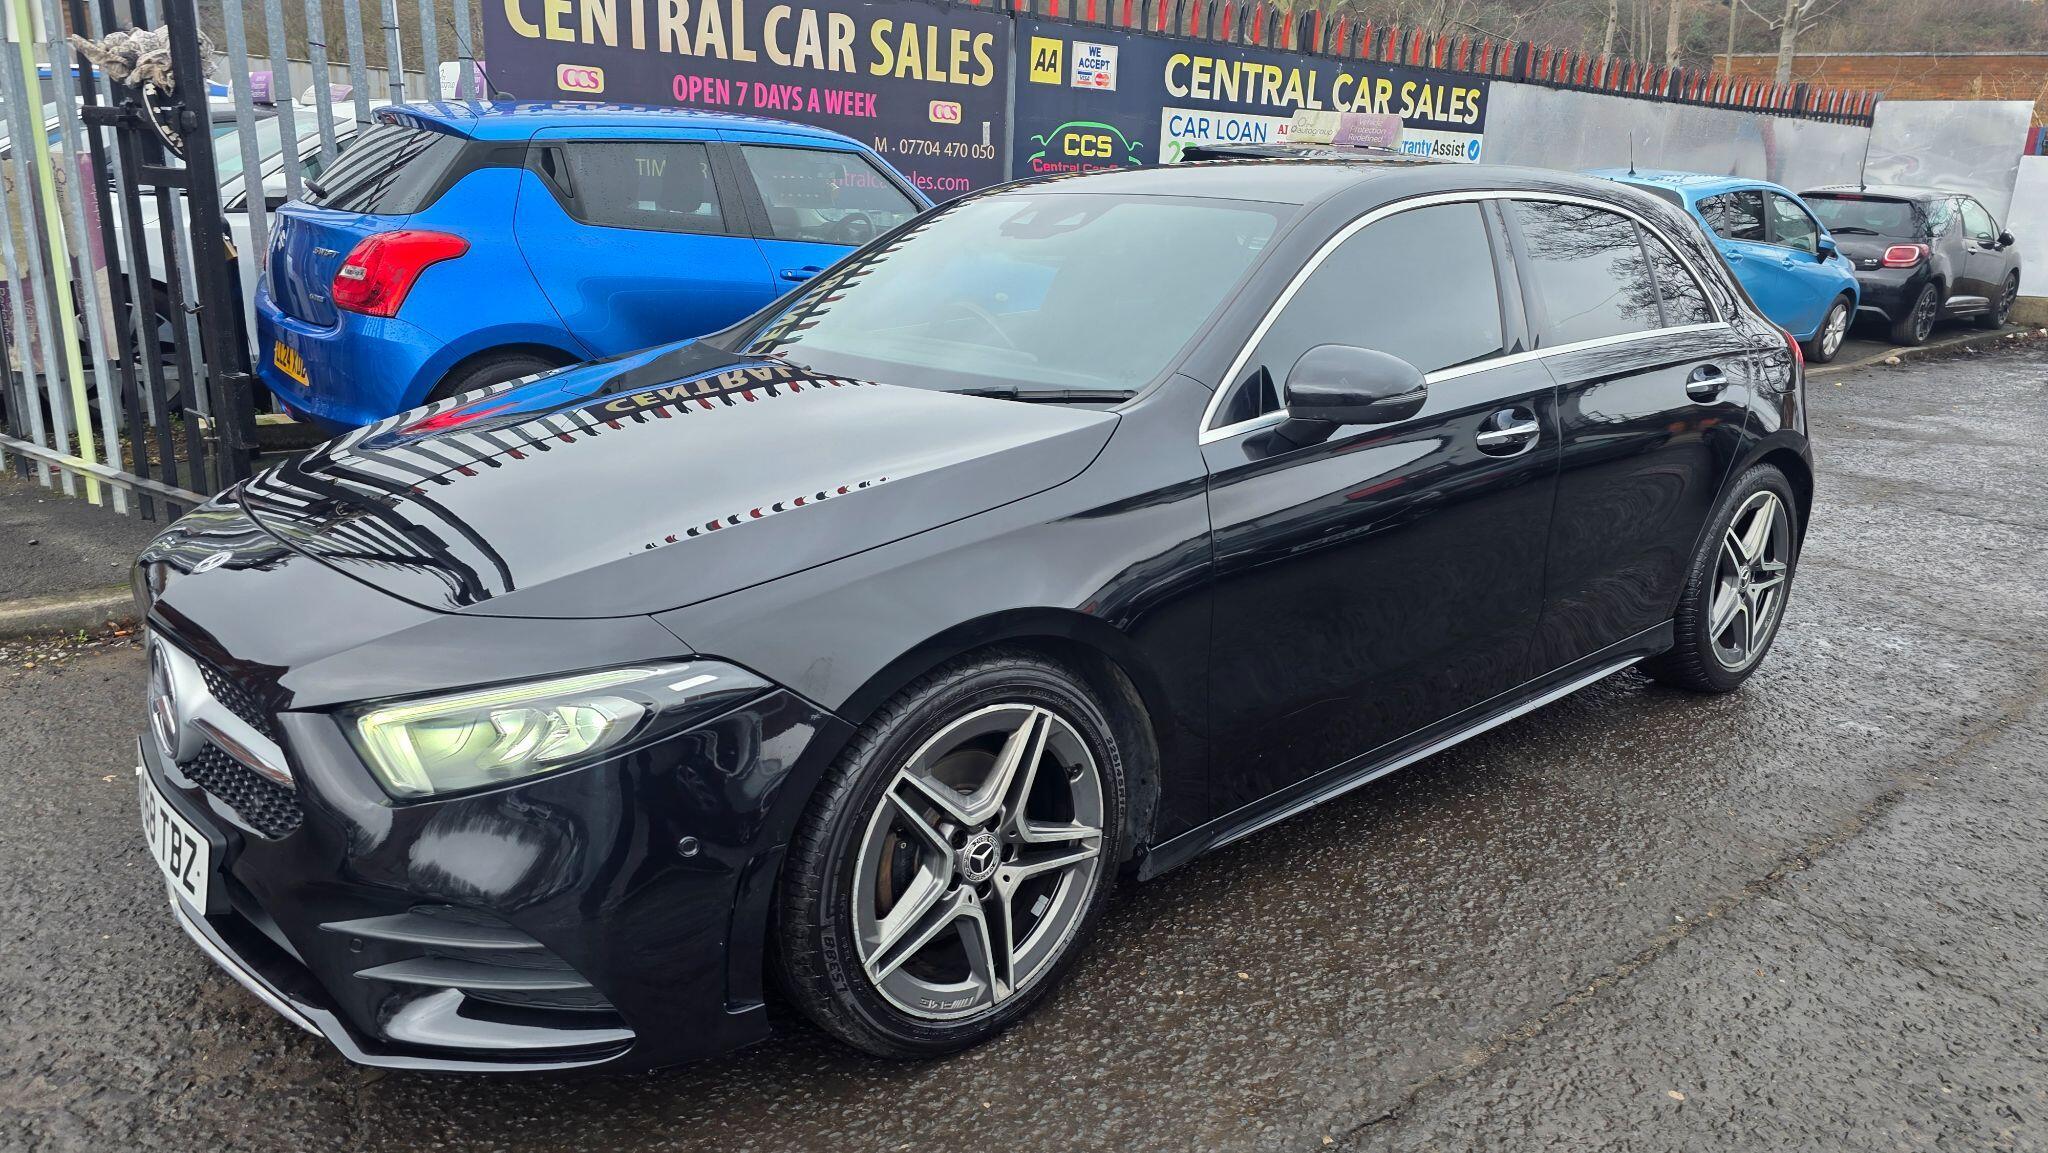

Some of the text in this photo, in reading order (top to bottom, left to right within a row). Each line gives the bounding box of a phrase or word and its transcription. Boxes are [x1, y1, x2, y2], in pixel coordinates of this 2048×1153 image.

[504, 0, 994, 87] CENTRAL CAR SALES
[1089, 46, 1102, 57] WE
[1034, 48, 1058, 73] AA
[1078, 57, 1111, 71] ACCEPT
[562, 68, 600, 89] CCS
[1164, 53, 1481, 125] CENTRAL CAR SALES
[673, 74, 877, 117] OPEN 7 DAYS A WEEK
[933, 104, 958, 120] CCS
[1169, 115, 1267, 142] CAR LOAN
[1348, 134, 1383, 143] Redefined
[1349, 126, 1386, 135] Protection
[874, 136, 888, 153] M
[900, 138, 940, 157] 07704
[944, 142, 968, 158] 470
[971, 144, 995, 160] 050
[1064, 133, 1112, 158] CCS
[1032, 158, 1079, 173] Central
[160, 806, 197, 895] TBZ
